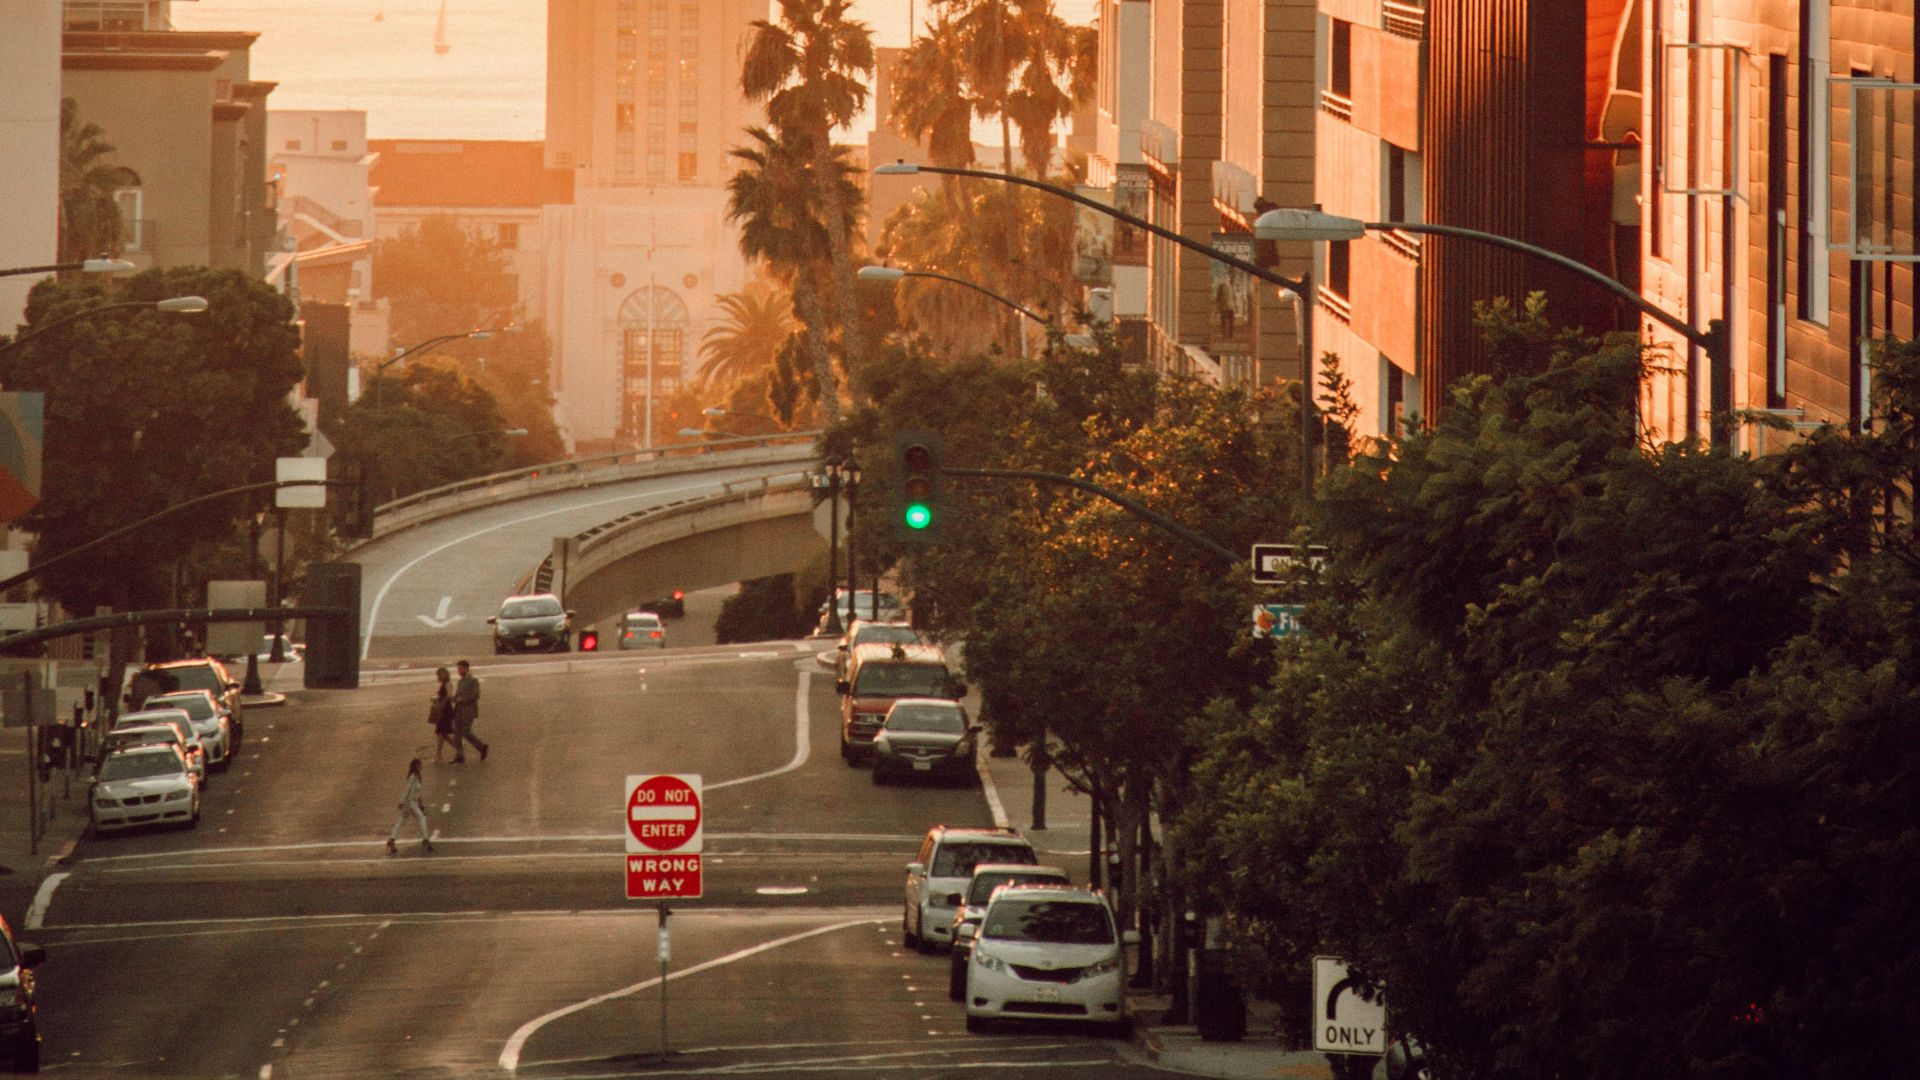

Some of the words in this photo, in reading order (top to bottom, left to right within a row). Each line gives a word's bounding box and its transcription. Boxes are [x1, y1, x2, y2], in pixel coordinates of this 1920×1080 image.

[637, 789, 656, 803] DO
[664, 789, 691, 802] NOT
[641, 823, 686, 838] ENTER
[629, 858, 699, 873] WRONG
[642, 878, 685, 892] WAY
[1326, 1025, 1376, 1045] ONLY
